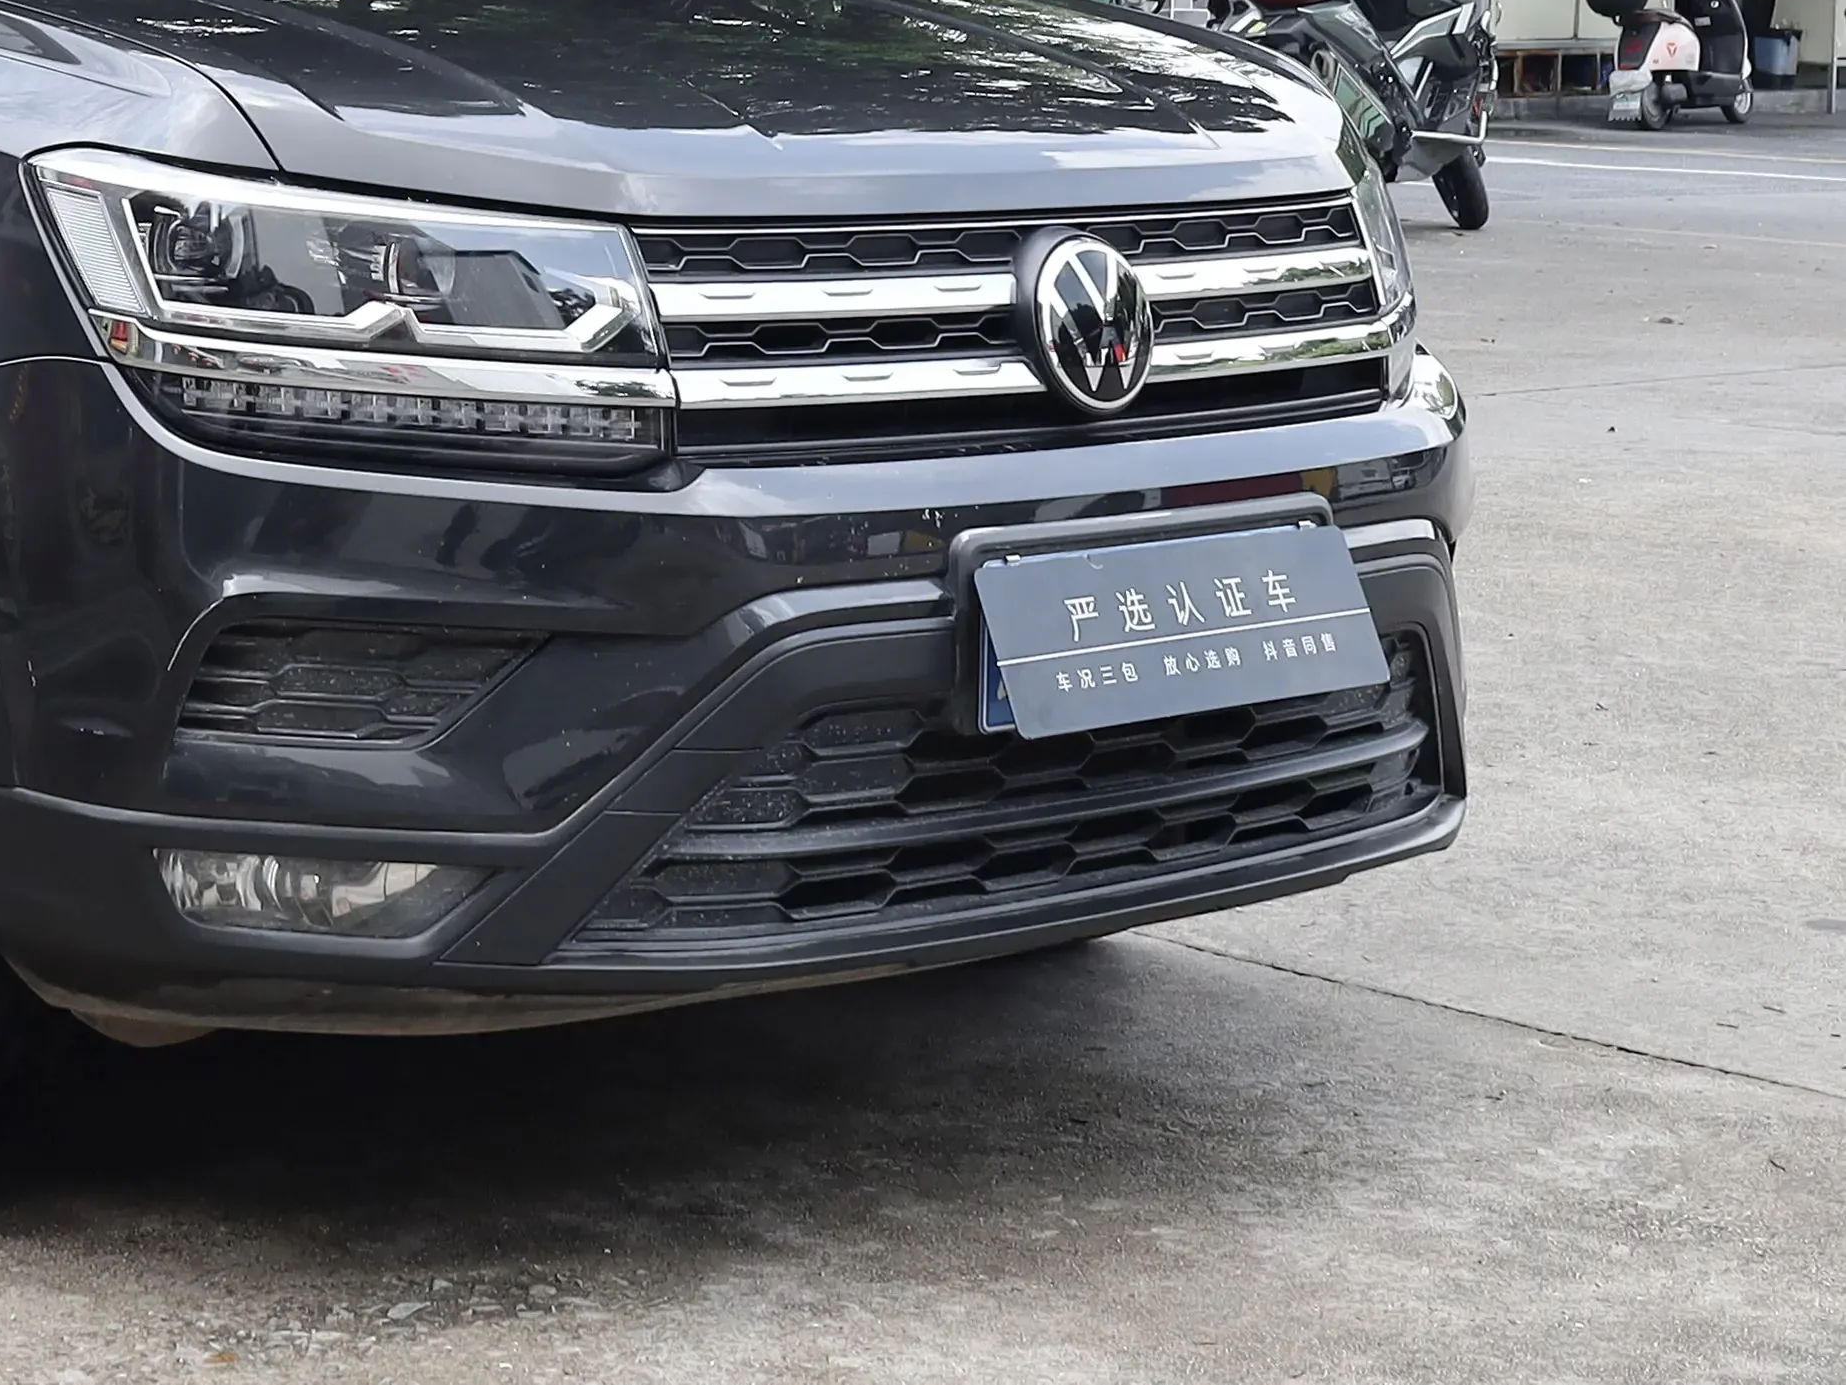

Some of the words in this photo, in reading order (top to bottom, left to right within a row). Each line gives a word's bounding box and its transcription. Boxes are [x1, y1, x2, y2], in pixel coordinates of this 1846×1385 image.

[1063, 569, 1297, 642] 严选认证车
[1055, 662, 1139, 692] 车况三包
[1163, 647, 1242, 677] 放心选购
[1262, 631, 1337, 662] 抖音同售
